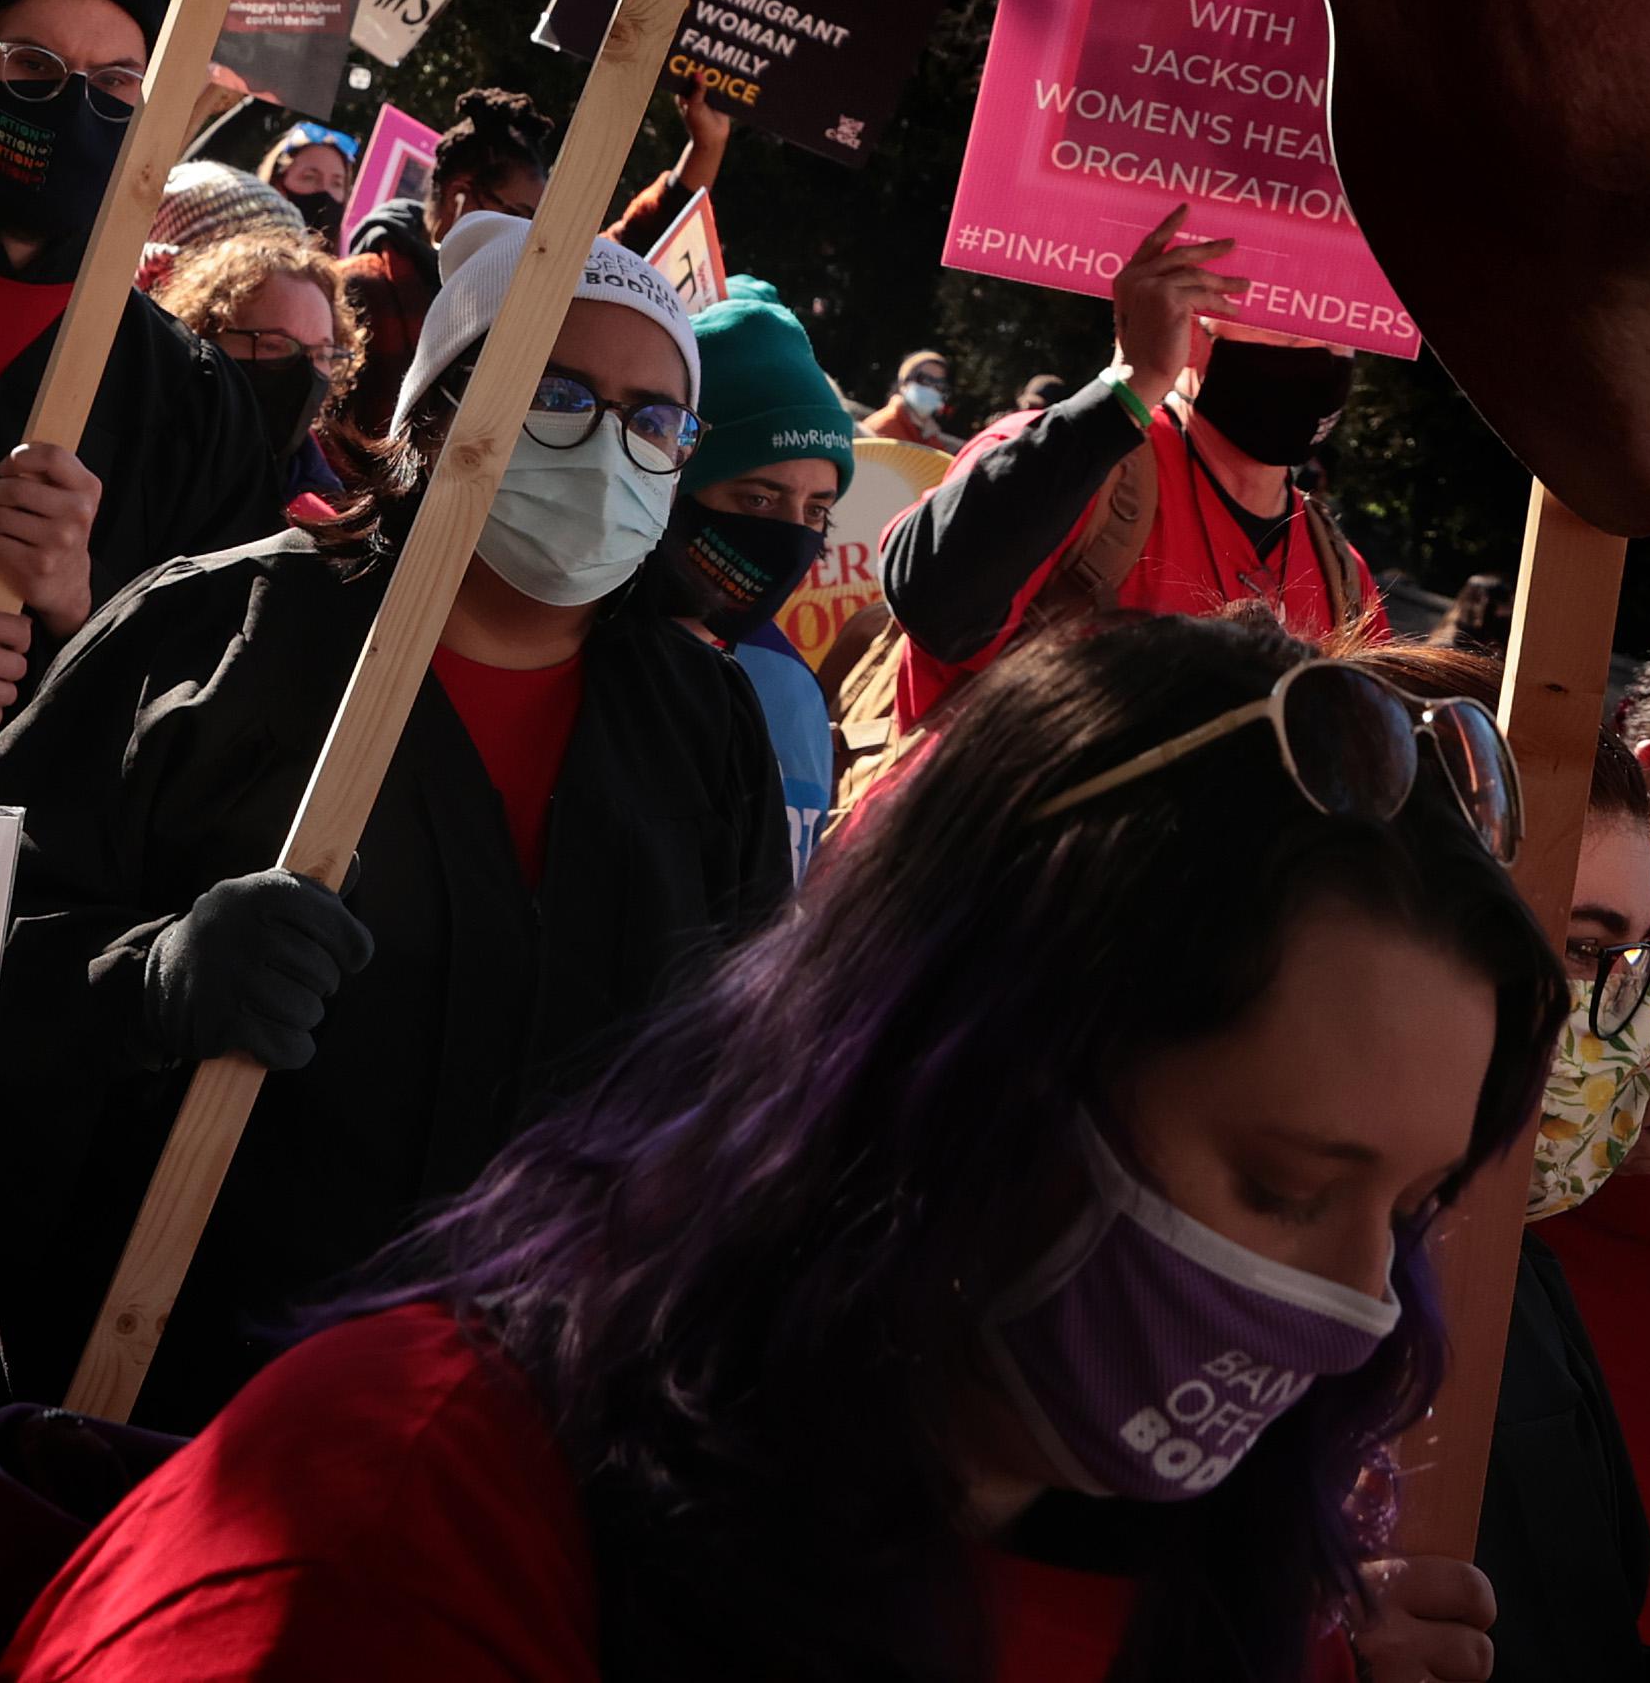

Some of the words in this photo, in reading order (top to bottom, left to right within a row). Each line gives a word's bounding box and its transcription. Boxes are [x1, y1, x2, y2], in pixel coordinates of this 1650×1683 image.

[679, 28, 770, 78] FAMILY
[696, 0, 798, 58] WOMAN
[669, 55, 762, 106] CHOICE
[1132, 44, 1325, 108] JACKSON
[1034, 79, 1233, 145] WOMEN'S
[1244, 120, 1335, 167] HEA
[1051, 140, 1358, 227] ORGANIZATION
[586, 272, 677, 319] BODIES
[686, 543, 747, 602] ABORTION
[694, 535, 753, 592] ABORTION
[1203, 1351, 1316, 1404] BAN
